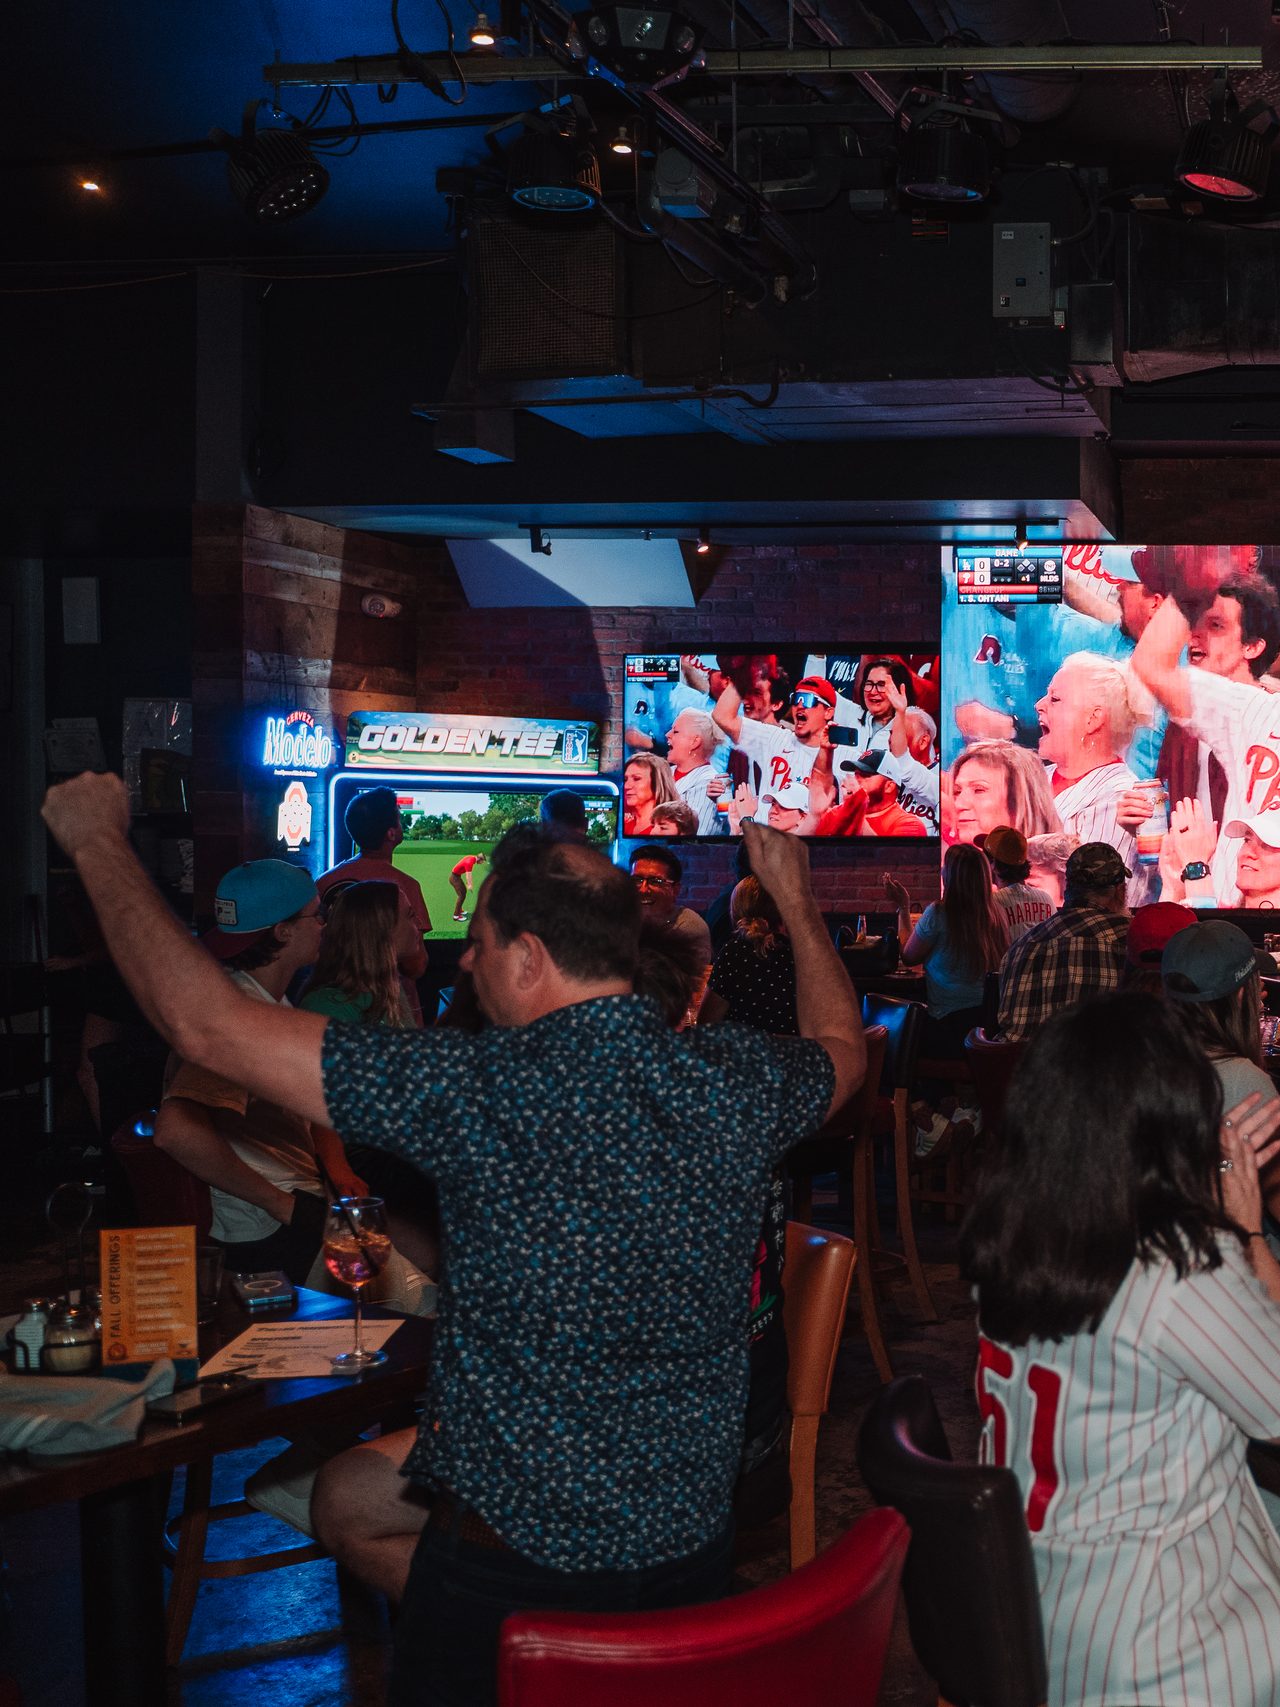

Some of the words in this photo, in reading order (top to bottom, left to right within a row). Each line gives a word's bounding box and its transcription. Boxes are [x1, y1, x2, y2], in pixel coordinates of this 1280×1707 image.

[995, 549, 1018, 557] GAME
[979, 561, 985, 570] 0
[994, 559, 1010, 568] 0-2
[979, 574, 985, 584] 0
[960, 586, 1005, 594] CHANGEUP
[286, 711, 315, 729] CERVEZA
[263, 717, 332, 769] Modelo
[358, 724, 491, 754] GOLDEN
[500, 730, 559, 758] TEE
[1006, 903, 1051, 926] HARPER
[110, 1235, 121, 1305] OFFERINGS
[110, 1310, 121, 1339] FALL
